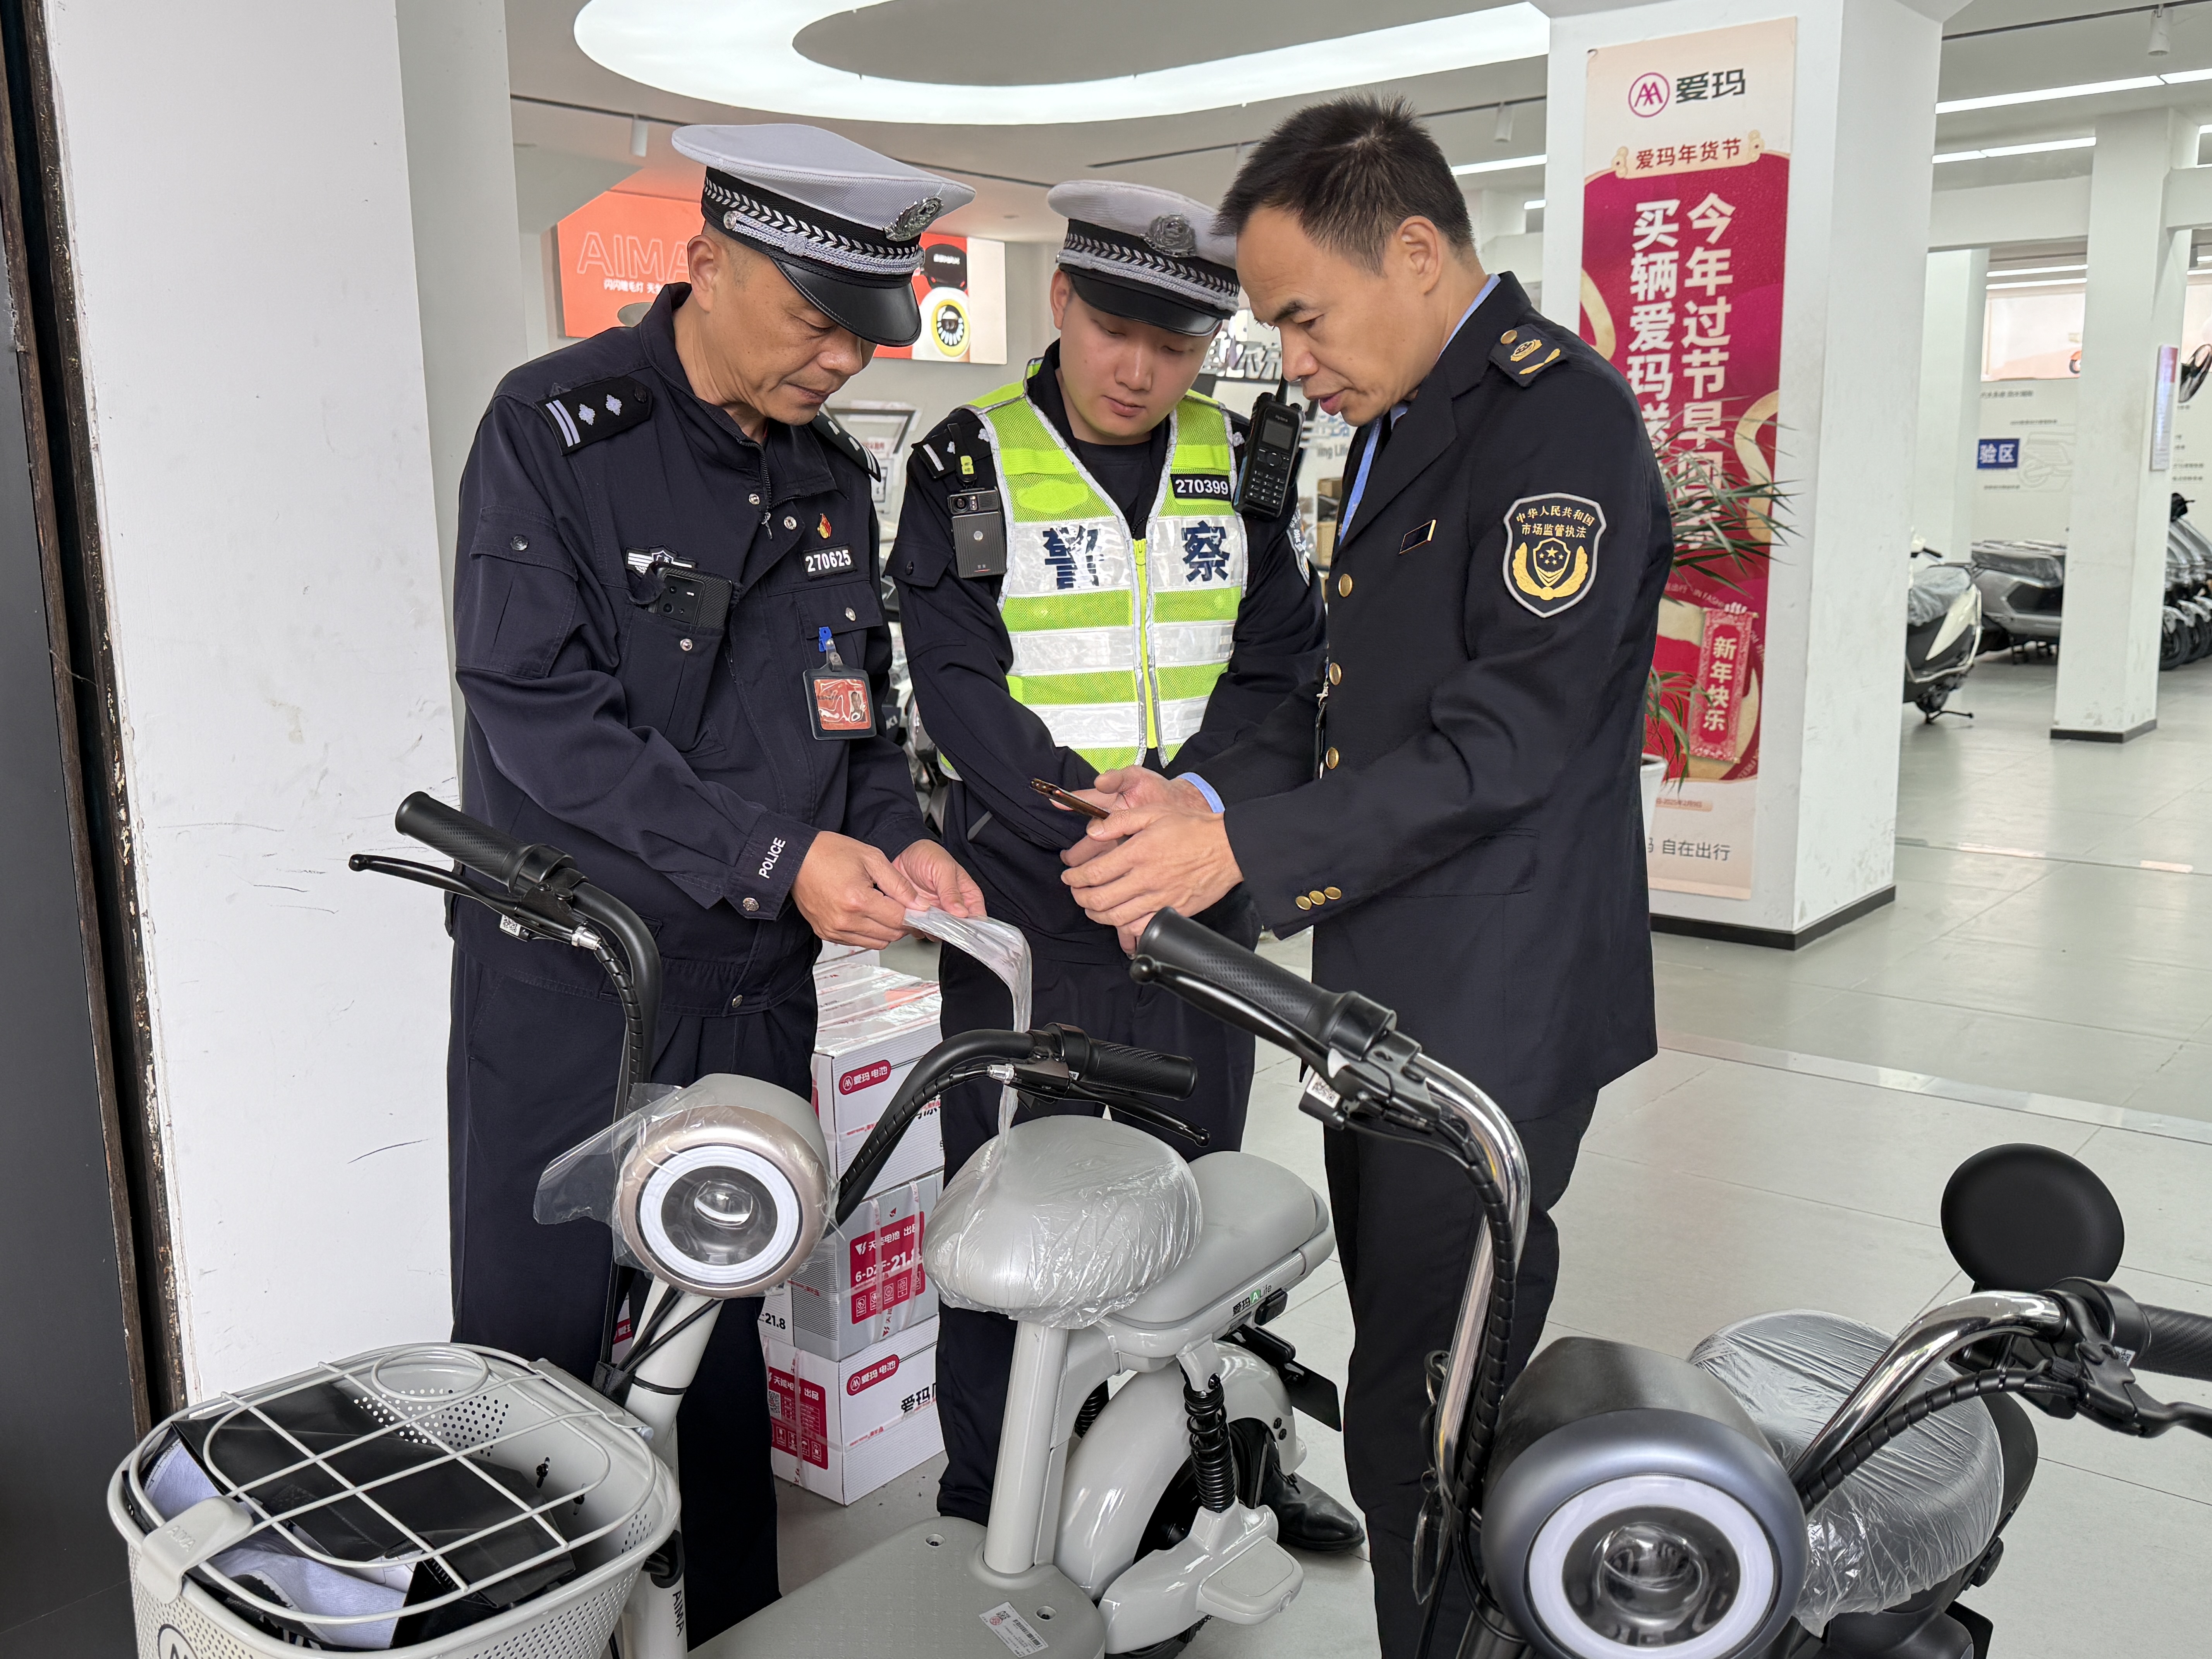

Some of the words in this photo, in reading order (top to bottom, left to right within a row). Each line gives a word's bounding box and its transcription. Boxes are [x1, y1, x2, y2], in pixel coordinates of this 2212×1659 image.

[1676, 69, 1745, 104] 爱玛
[1636, 137, 1741, 170] 爱玛年货节
[577, 231, 691, 282] AIMA
[1176, 478, 1229, 495] 270399
[1516, 505, 1595, 527] 中华人民共和国
[1522, 523, 1587, 538] 市场监管执法
[805, 549, 852, 573] 270625
[1703, 635, 1737, 732] 新年快乐
[758, 837, 786, 879] POLICE
[1662, 838, 1731, 862] 自在出行
[871, 1065, 888, 1078] 电池
[879, 1360, 896, 1374] 电池
[773, 1376, 801, 1394] 天能电
[804, 1388, 819, 1401] 出品
[901, 1382, 936, 1413] 爱玛
[167, 1525, 196, 1553] AIMA
[672, 1589, 684, 1637] AIMA
